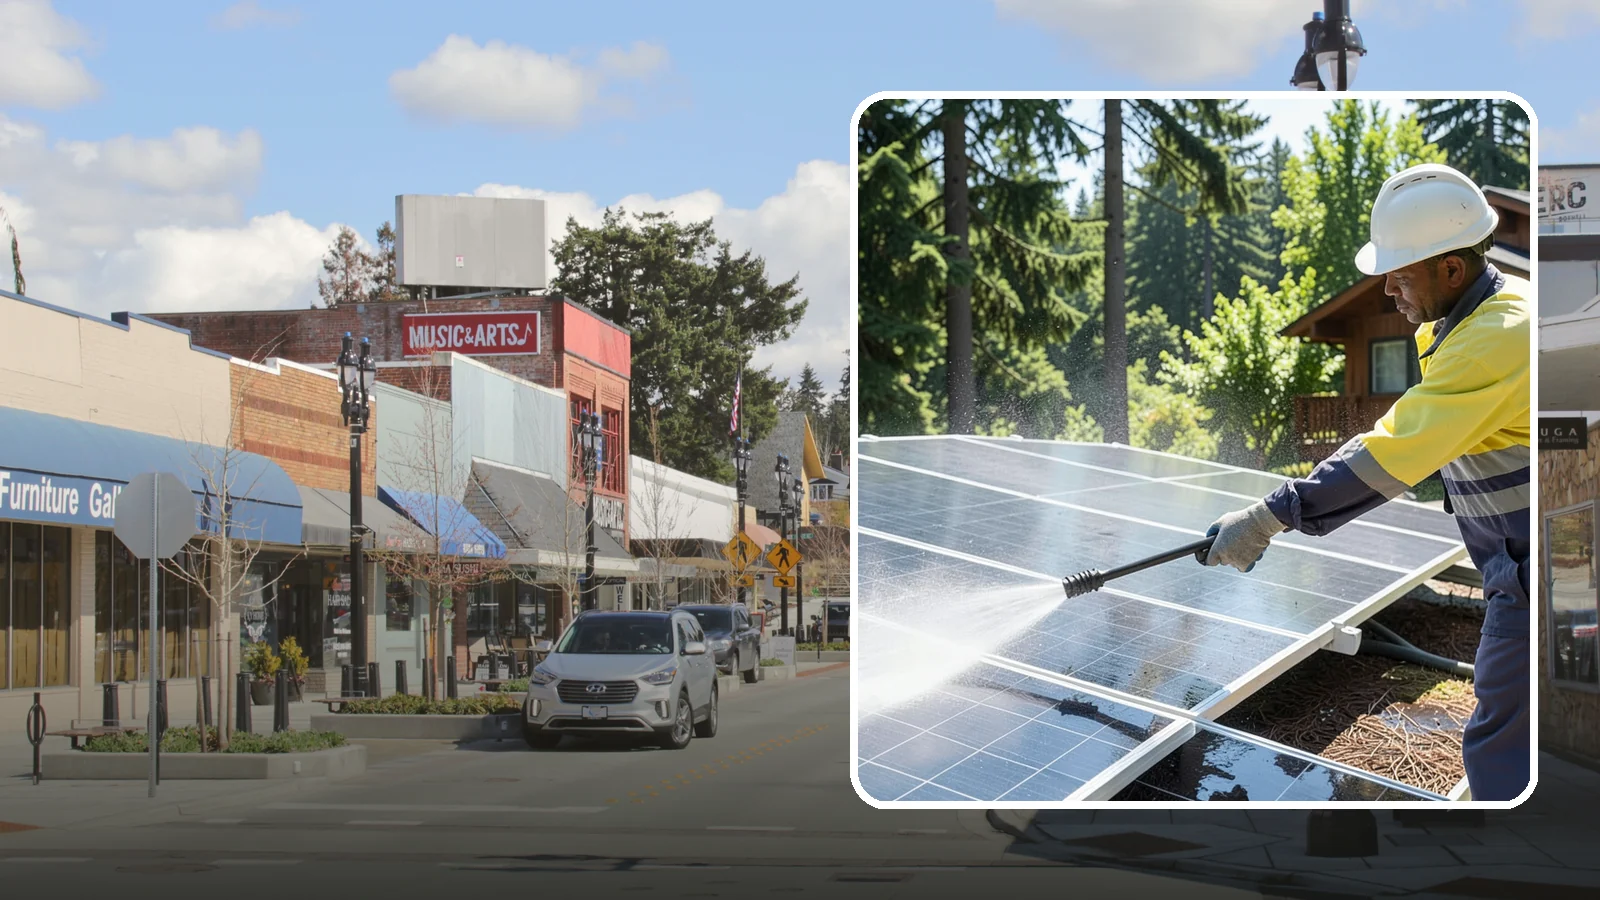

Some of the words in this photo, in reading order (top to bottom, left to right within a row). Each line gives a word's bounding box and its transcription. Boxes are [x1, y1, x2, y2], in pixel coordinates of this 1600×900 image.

[409, 323, 520, 349] MUSIC&ARTS
[0, 471, 79, 515] Furniture
[89, 482, 121, 519] Gal
